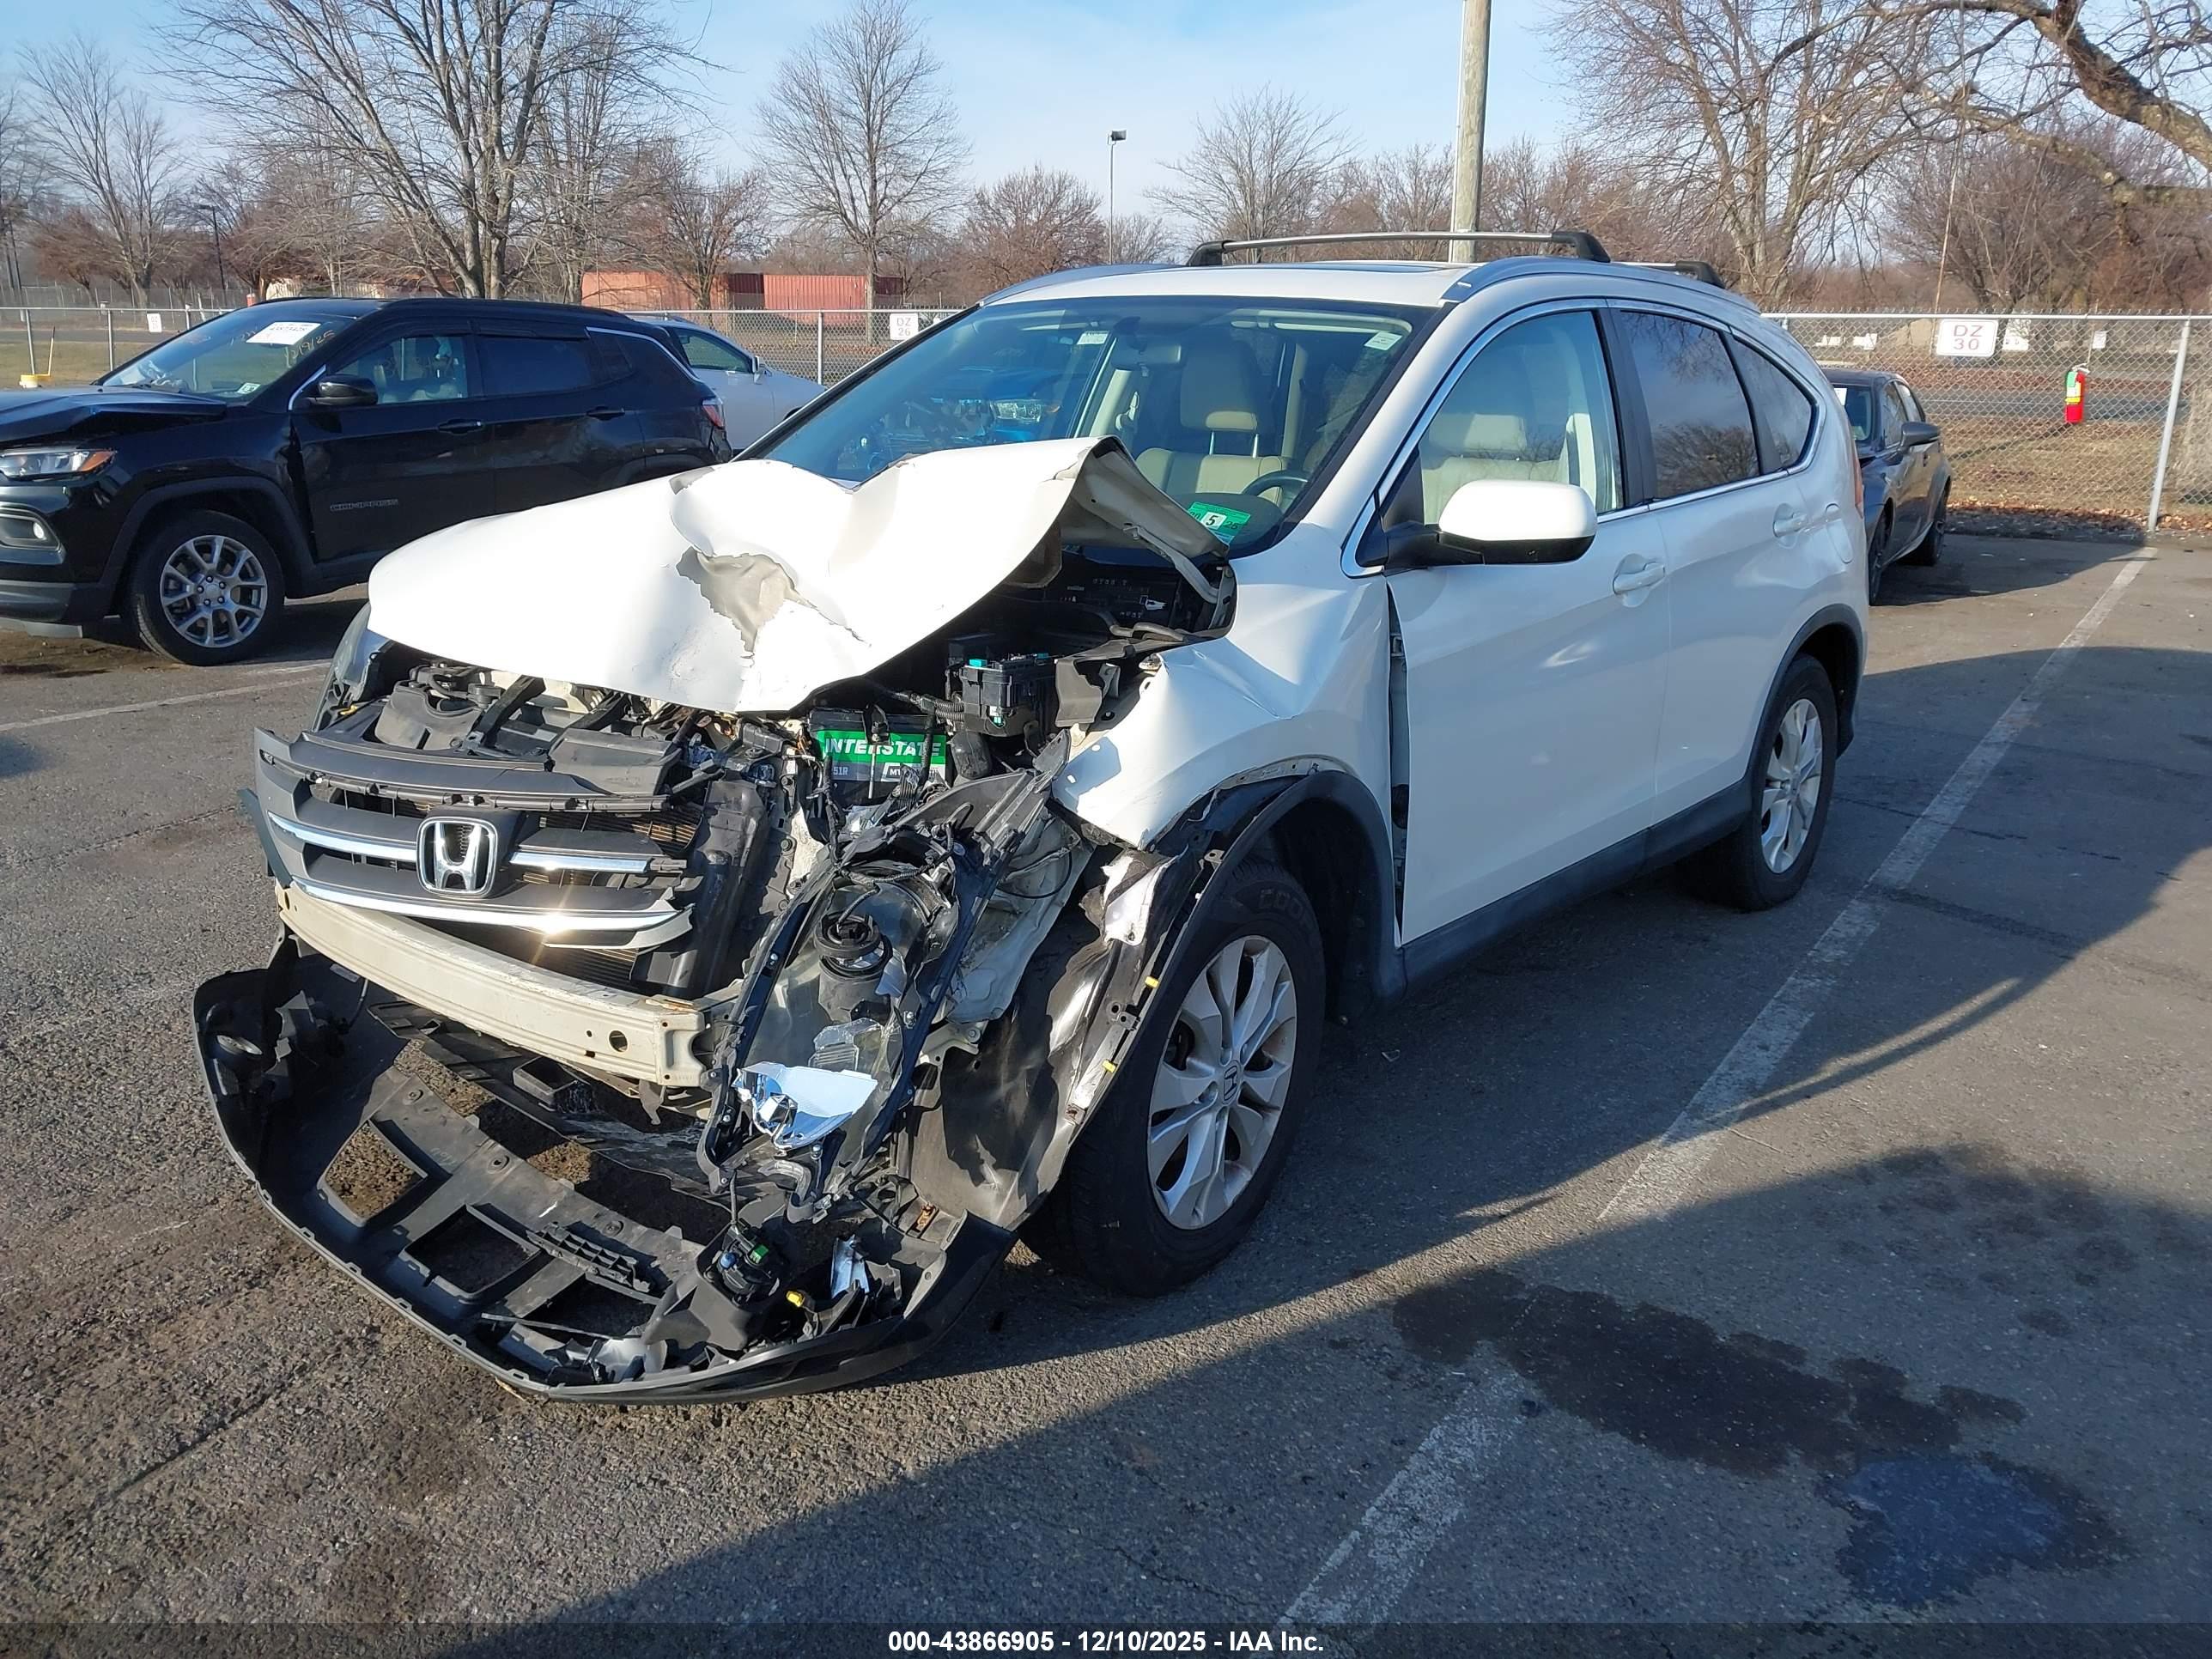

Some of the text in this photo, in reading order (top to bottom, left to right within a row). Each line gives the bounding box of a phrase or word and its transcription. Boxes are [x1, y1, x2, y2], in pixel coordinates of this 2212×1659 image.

[896, 318, 911, 326] DZ
[898, 327, 911, 336] 26
[1954, 325, 1984, 337] DZ
[1954, 338, 1980, 350] 30
[1206, 515, 1218, 526] 5
[833, 766, 848, 775] 51R
